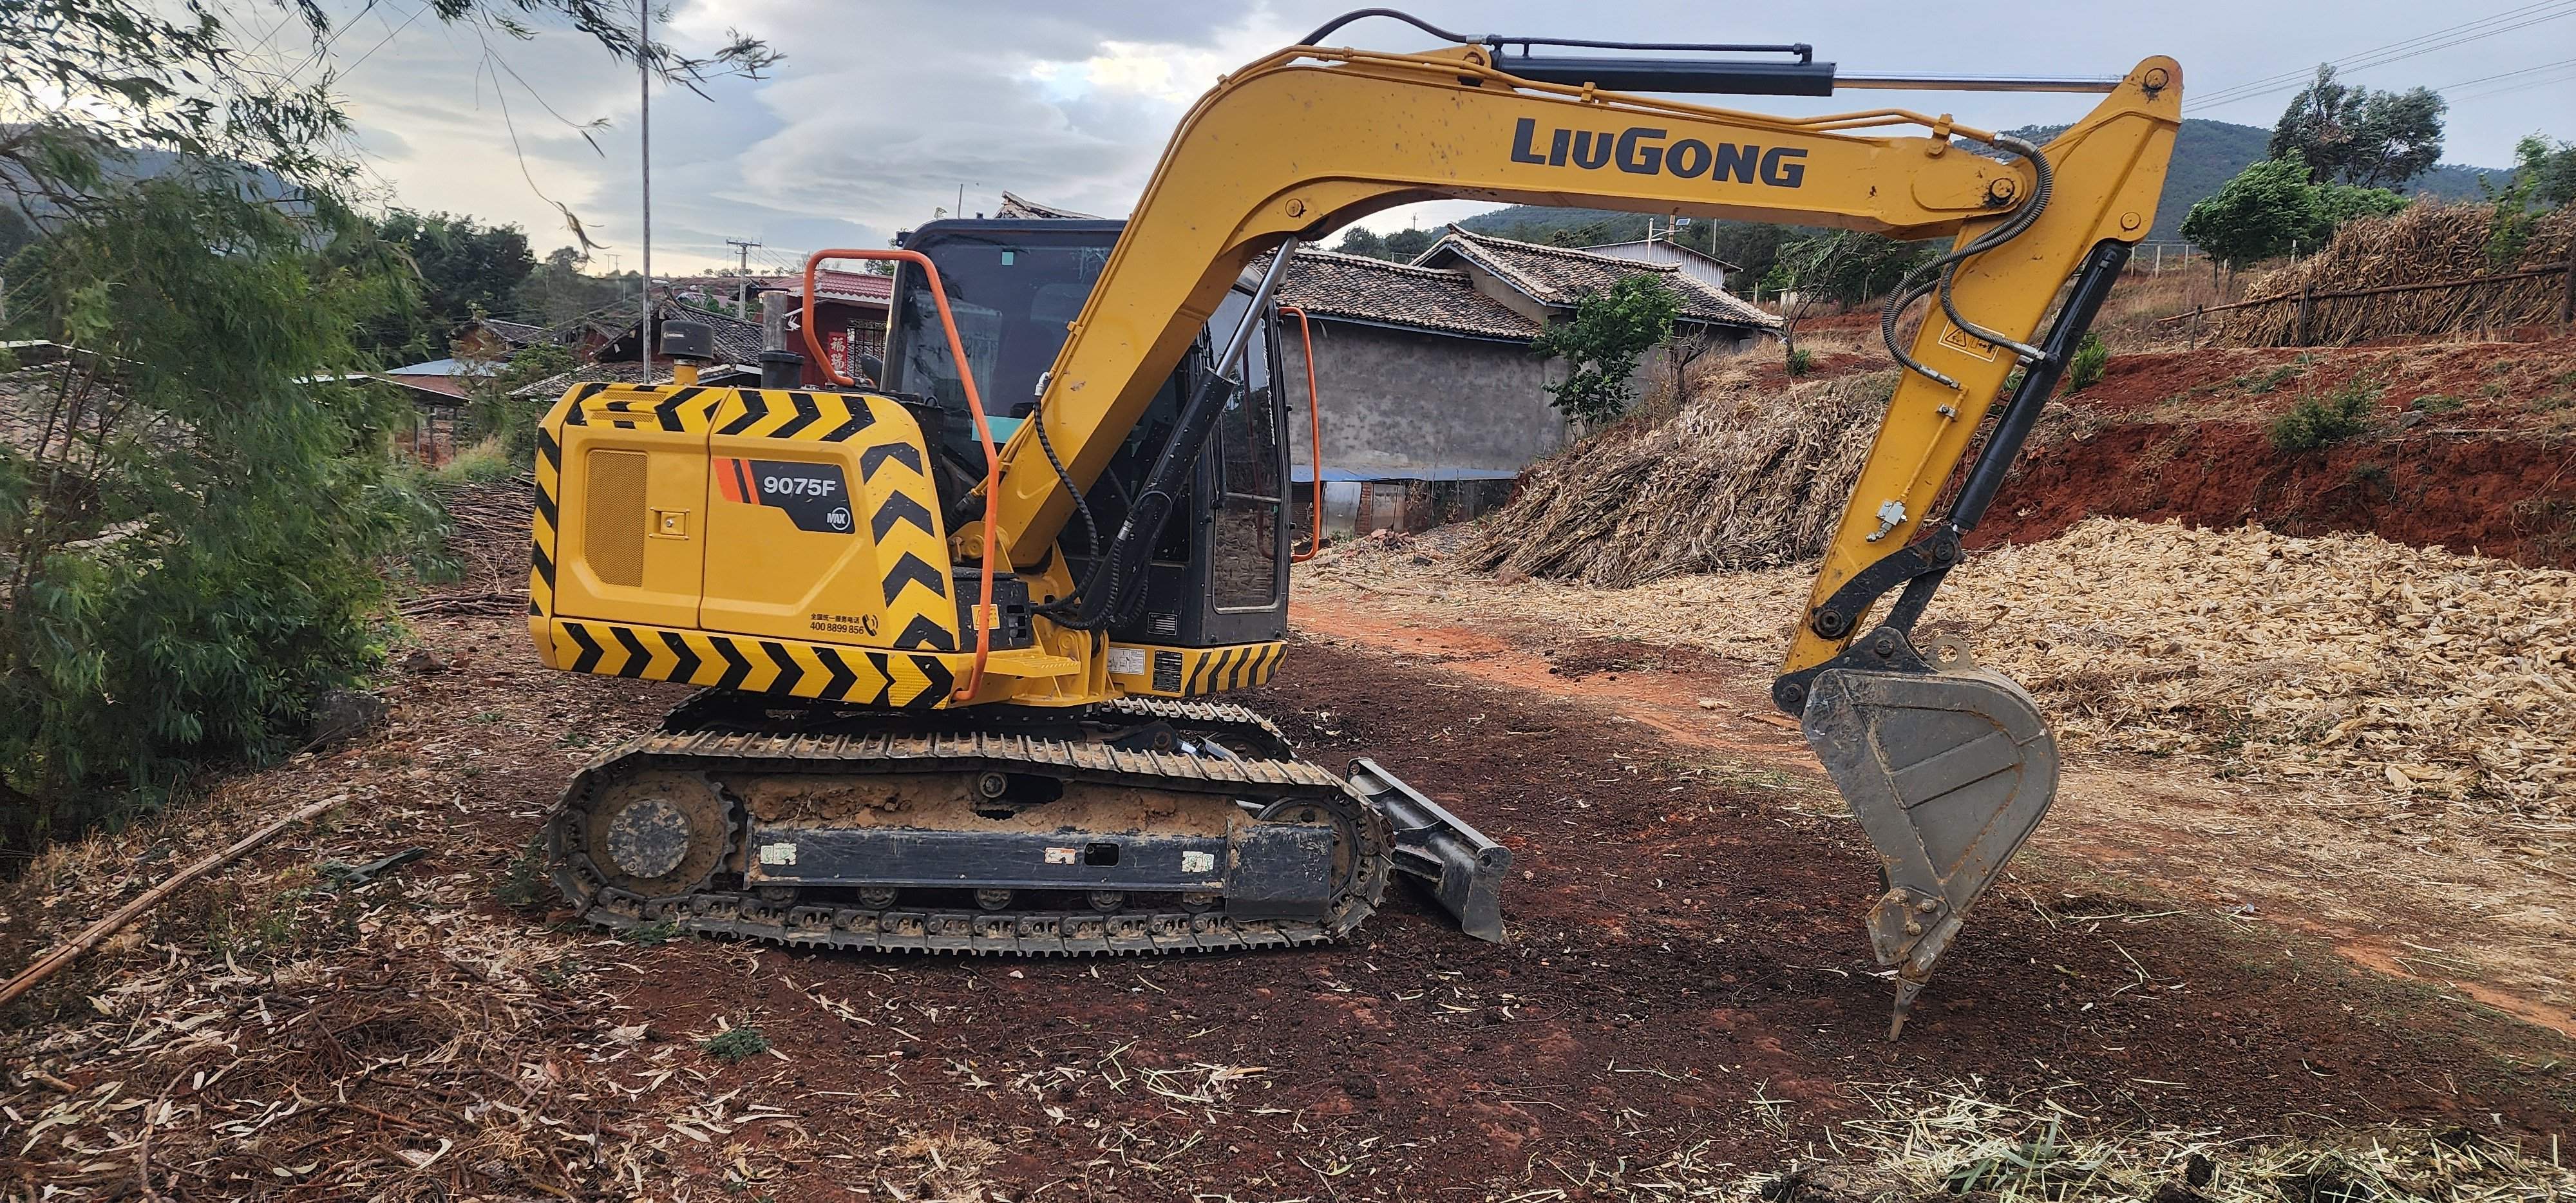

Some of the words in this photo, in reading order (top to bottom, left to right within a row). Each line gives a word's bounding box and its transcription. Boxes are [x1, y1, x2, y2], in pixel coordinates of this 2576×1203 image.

[764, 476, 836, 497] 9075F
[827, 513, 846, 525] MAX
[810, 621, 826, 631] 400
[827, 623, 848, 632] 8899
[849, 625, 864, 634] 856
